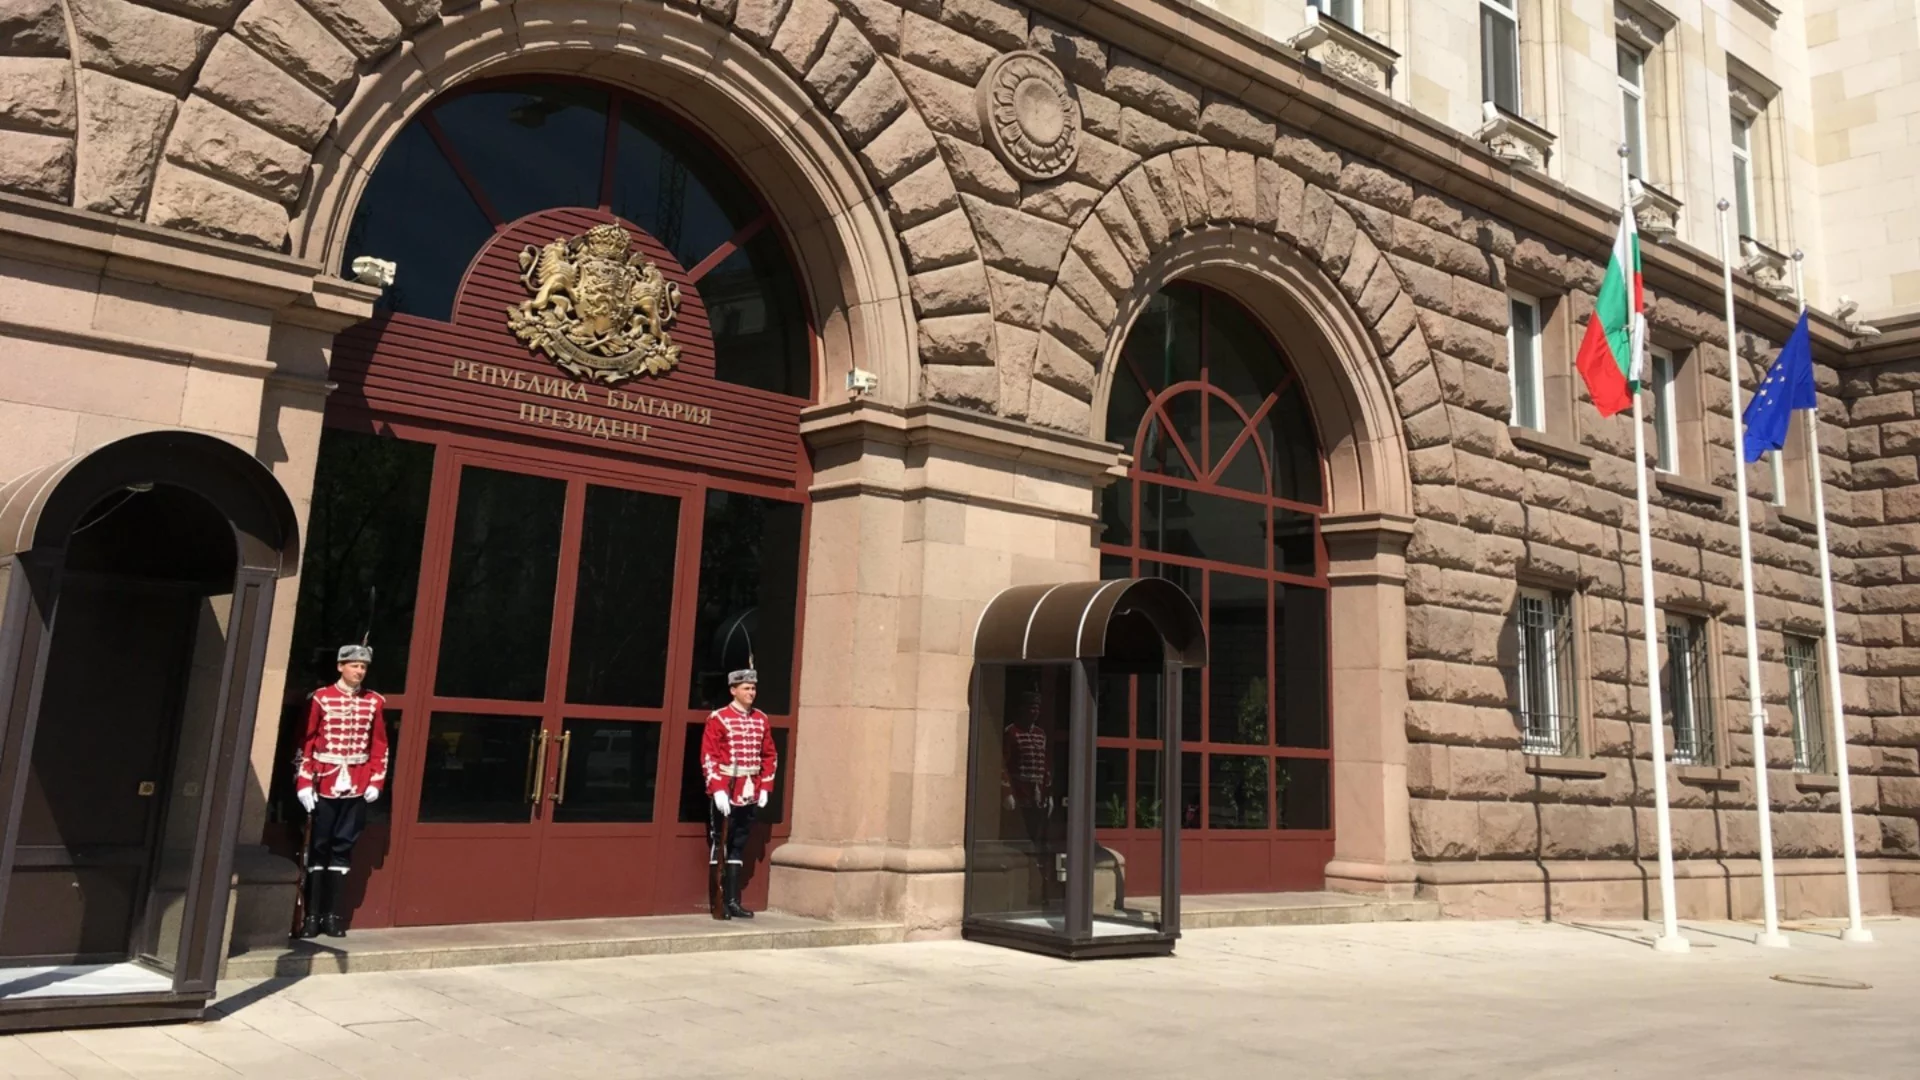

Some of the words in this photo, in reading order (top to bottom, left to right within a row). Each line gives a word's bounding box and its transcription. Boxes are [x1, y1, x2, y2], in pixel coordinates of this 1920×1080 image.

[452, 359, 588, 402] РЕПУБЛИКА
[607, 389, 712, 425] БЪЛГАРИЯ
[519, 402, 652, 441] ПРЕЗИДЕНТ
